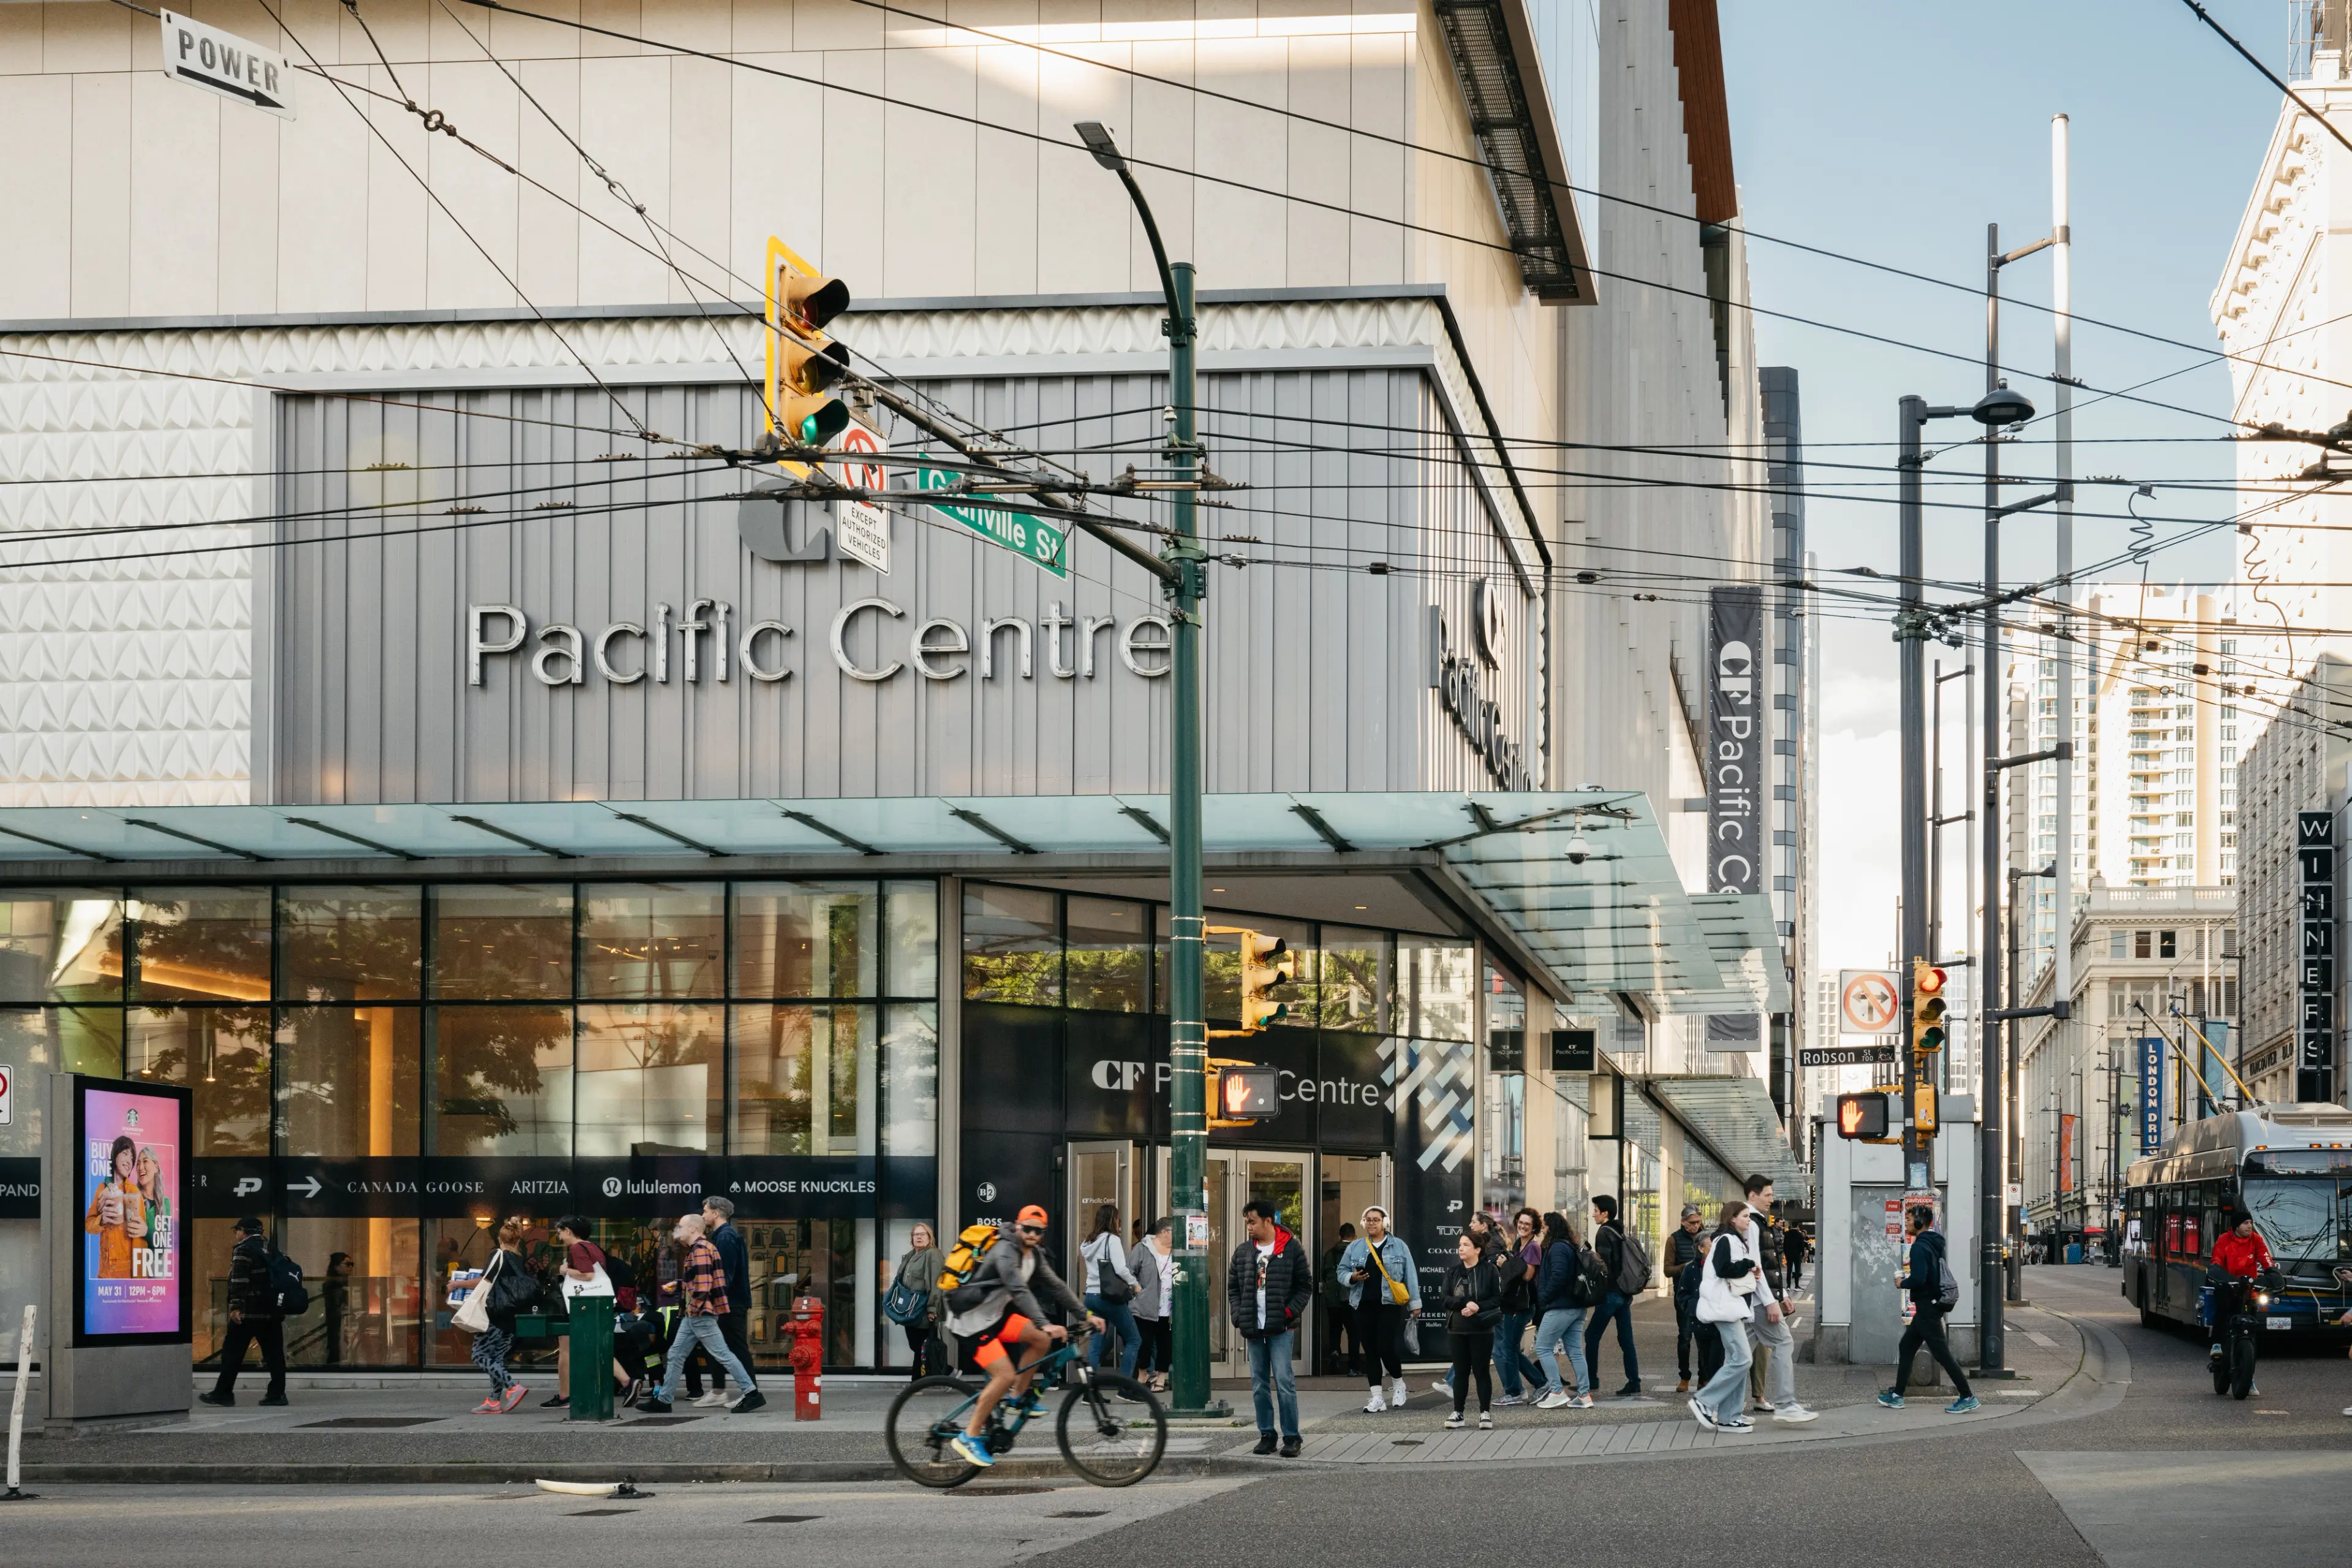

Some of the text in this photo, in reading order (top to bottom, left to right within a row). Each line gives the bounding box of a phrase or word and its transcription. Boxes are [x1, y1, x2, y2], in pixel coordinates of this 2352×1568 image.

[178, 28, 280, 94] POWER
[851, 507, 876, 529] EXCEPT
[842, 516, 886, 549] AUTHORIZED
[848, 533, 880, 560] VEHICLES
[1036, 528, 1058, 564] St
[469, 596, 1171, 686] Pacific Centre
[1720, 641, 1751, 705] CF
[1718, 716, 1751, 842] Pacific
[2301, 821, 2330, 1058] WINNERS
[1803, 1050, 1855, 1065] Robson
[1092, 1060, 1145, 1090] CF
[1280, 1071, 1379, 1106] Centre
[2147, 1044, 2157, 1107] LONDON
[91, 1142, 113, 1159] BUY
[91, 1159, 113, 1177] ONE
[347, 1182, 418, 1193] CANADA
[426, 1182, 484, 1193] GOOSE
[511, 1181, 569, 1194] ARITZIA
[627, 1179, 701, 1194] lululemon
[745, 1182, 796, 1193] MOOSE
[801, 1182, 875, 1193] KNUCKLES
[154, 1215, 172, 1231] GET
[977, 1218, 1002, 1226] BOSS
[153, 1231, 172, 1248] ONE
[133, 1248, 172, 1277] FREE
[98, 1286, 112, 1296] MAY
[114, 1286, 121, 1296] 31
[129, 1286, 145, 1296] 12PM
[152, 1286, 165, 1296] 6PM
